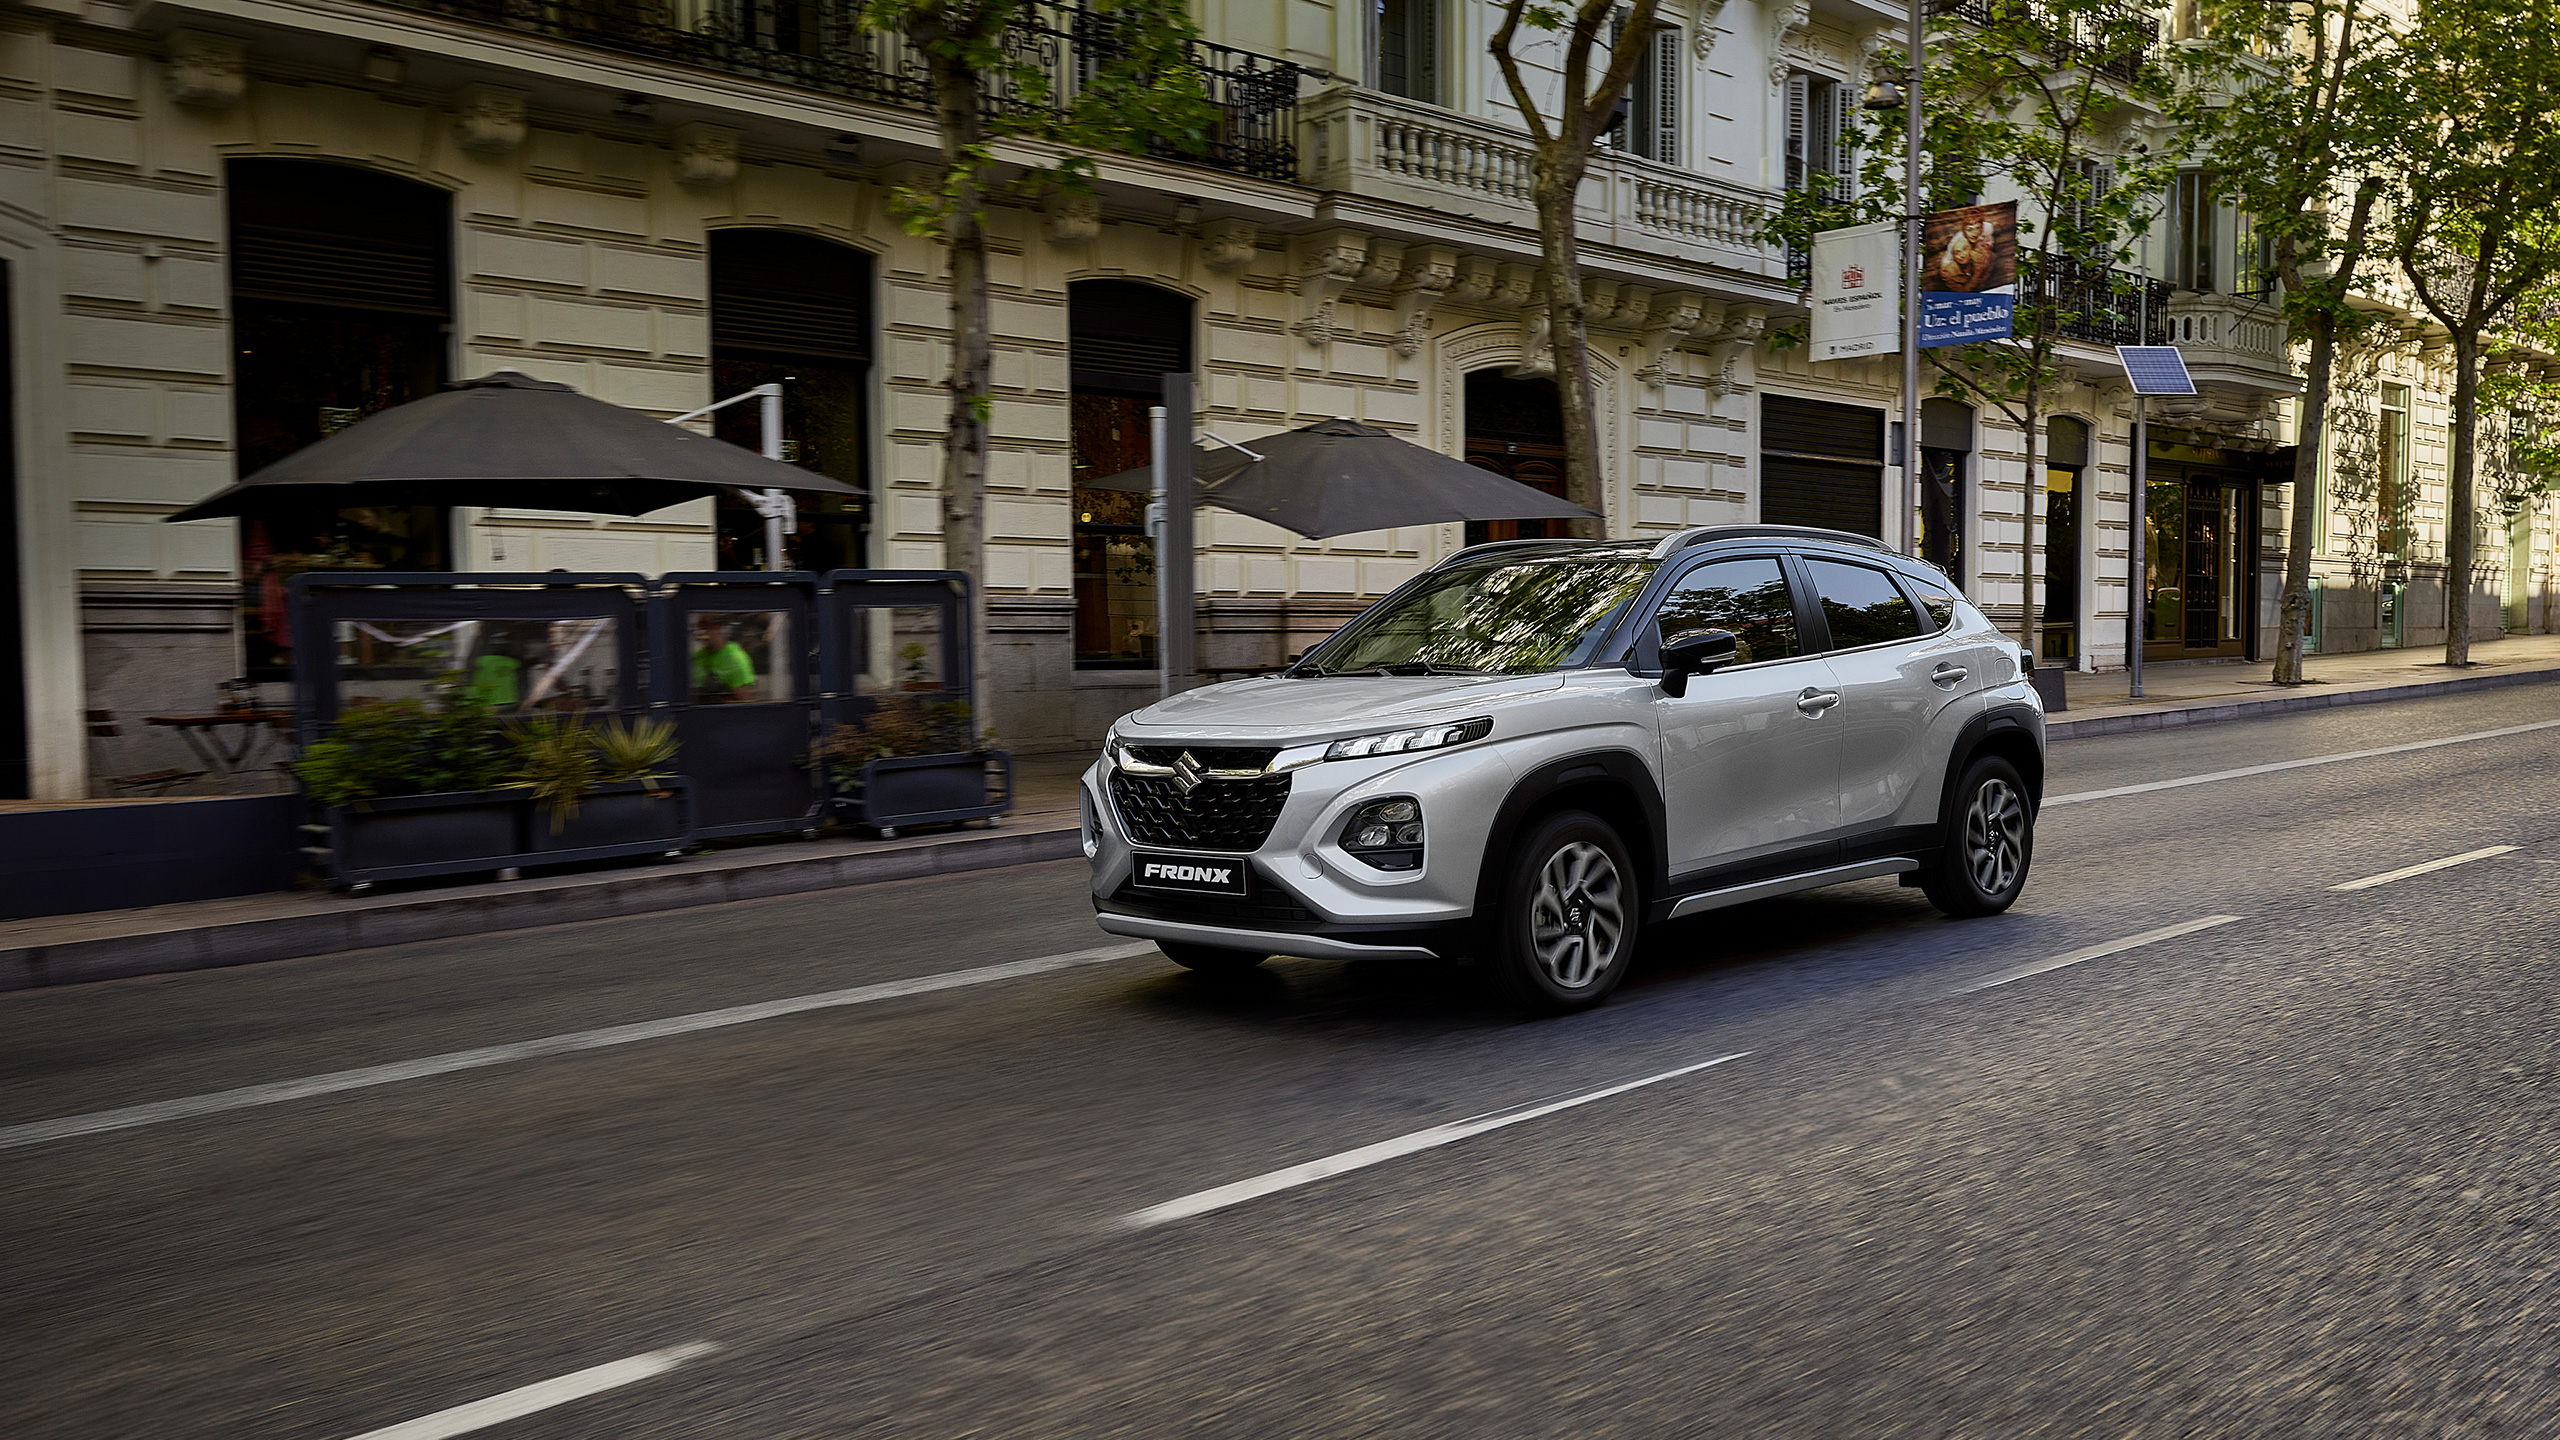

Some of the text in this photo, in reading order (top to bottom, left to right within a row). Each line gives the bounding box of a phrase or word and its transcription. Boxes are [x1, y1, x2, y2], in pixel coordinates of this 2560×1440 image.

[1949, 310, 1961, 325] el
[1963, 304, 2009, 329] pueblo
[1839, 341, 1875, 352] MADRID
[1144, 863, 1231, 884] FRONX
